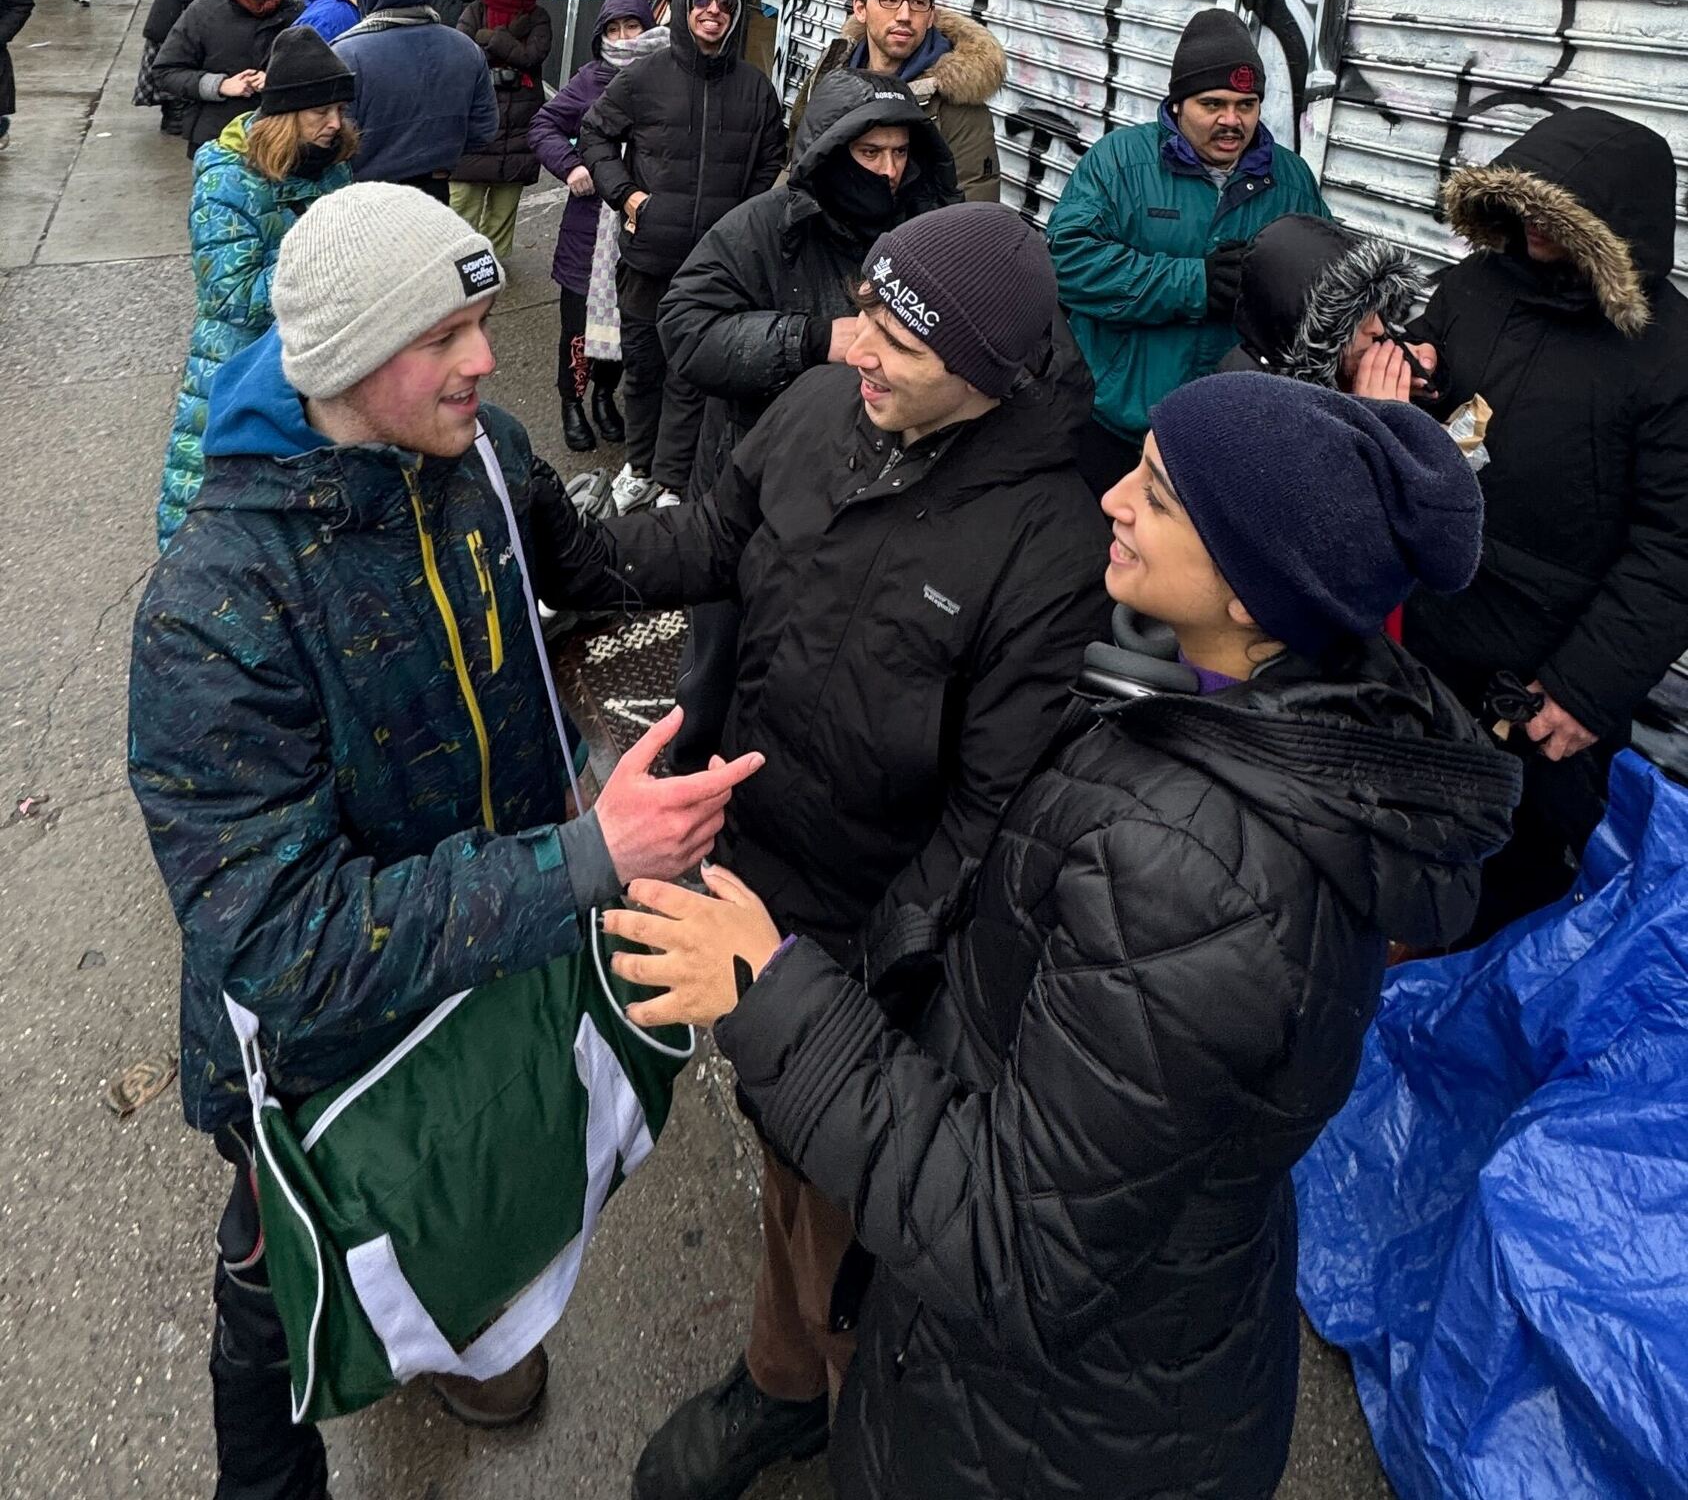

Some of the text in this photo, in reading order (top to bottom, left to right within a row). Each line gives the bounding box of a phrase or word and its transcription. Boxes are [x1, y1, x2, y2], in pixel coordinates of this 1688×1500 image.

[879, 287, 930, 336] on campus
[886, 279, 940, 327] AIPAC
